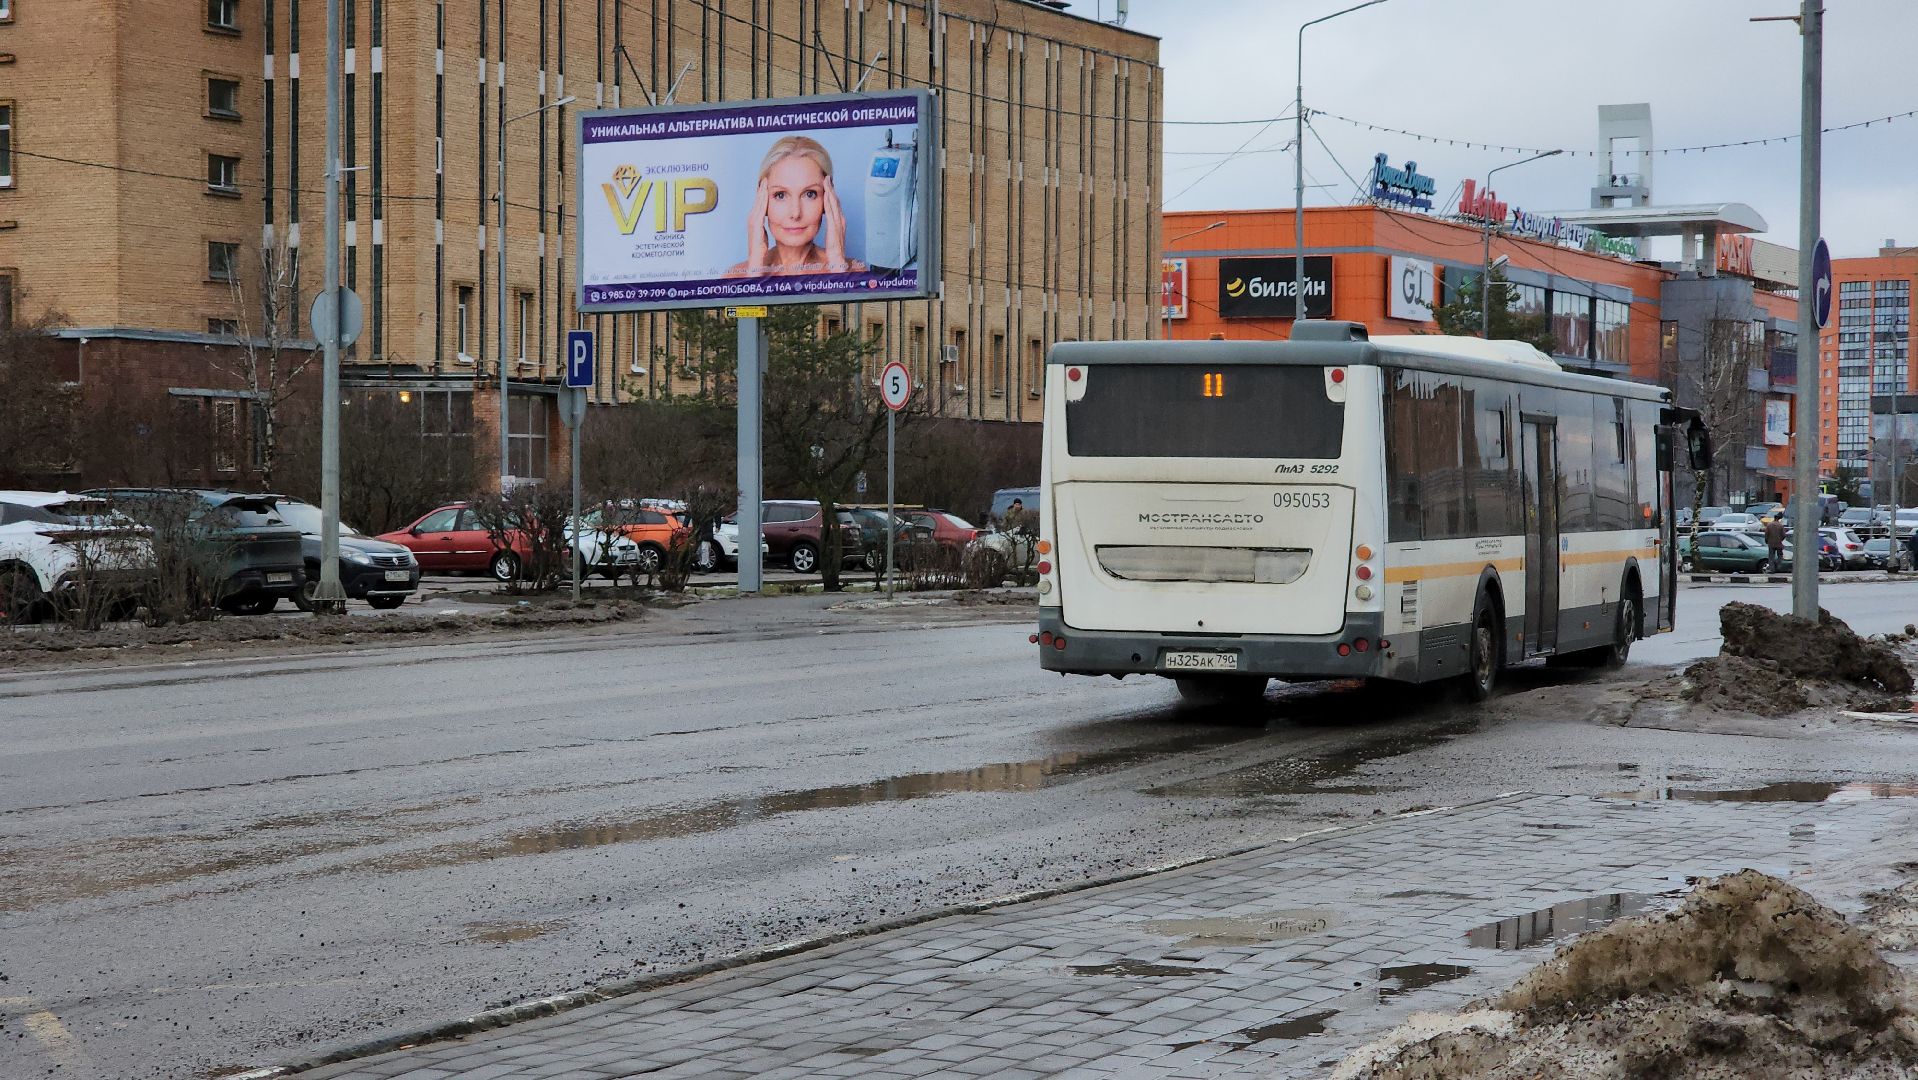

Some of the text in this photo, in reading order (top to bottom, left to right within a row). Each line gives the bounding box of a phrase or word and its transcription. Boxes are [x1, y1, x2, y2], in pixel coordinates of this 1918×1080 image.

[591, 106, 916, 138] УНИКАЛЬНАЯ АЛЬТЕРНАТИВА ПЛАСТИЧЕСКОЙ ОПЕРАЦИИ
[645, 163, 710, 175] ЭКСКЛЮЗИВНО
[601, 177, 719, 236] VIP
[654, 234, 685, 242] КЛИНИКА
[635, 241, 685, 251] ЭСТЕТИЧЕСКОЙ
[631, 250, 685, 259] КОСМЕТОЛОГИИ
[804, 279, 855, 292] vipdubna.ru
[1249, 276, 1326, 298] билайн
[1402, 267, 1423, 305] GJ
[601, 288, 666, 300] 8 985 09 39 709
[573, 340, 587, 376] P
[890, 376, 900, 395] 5
[1203, 373, 1223, 397] 11
[1274, 464, 1339, 474] ЛиАЗ 5292
[1273, 492, 1330, 508] 095053
[1138, 511, 1264, 524] МОСТРАНСАВТО
[1169, 654, 1214, 667] Н325АК
[1216, 654, 1234, 664] 790
